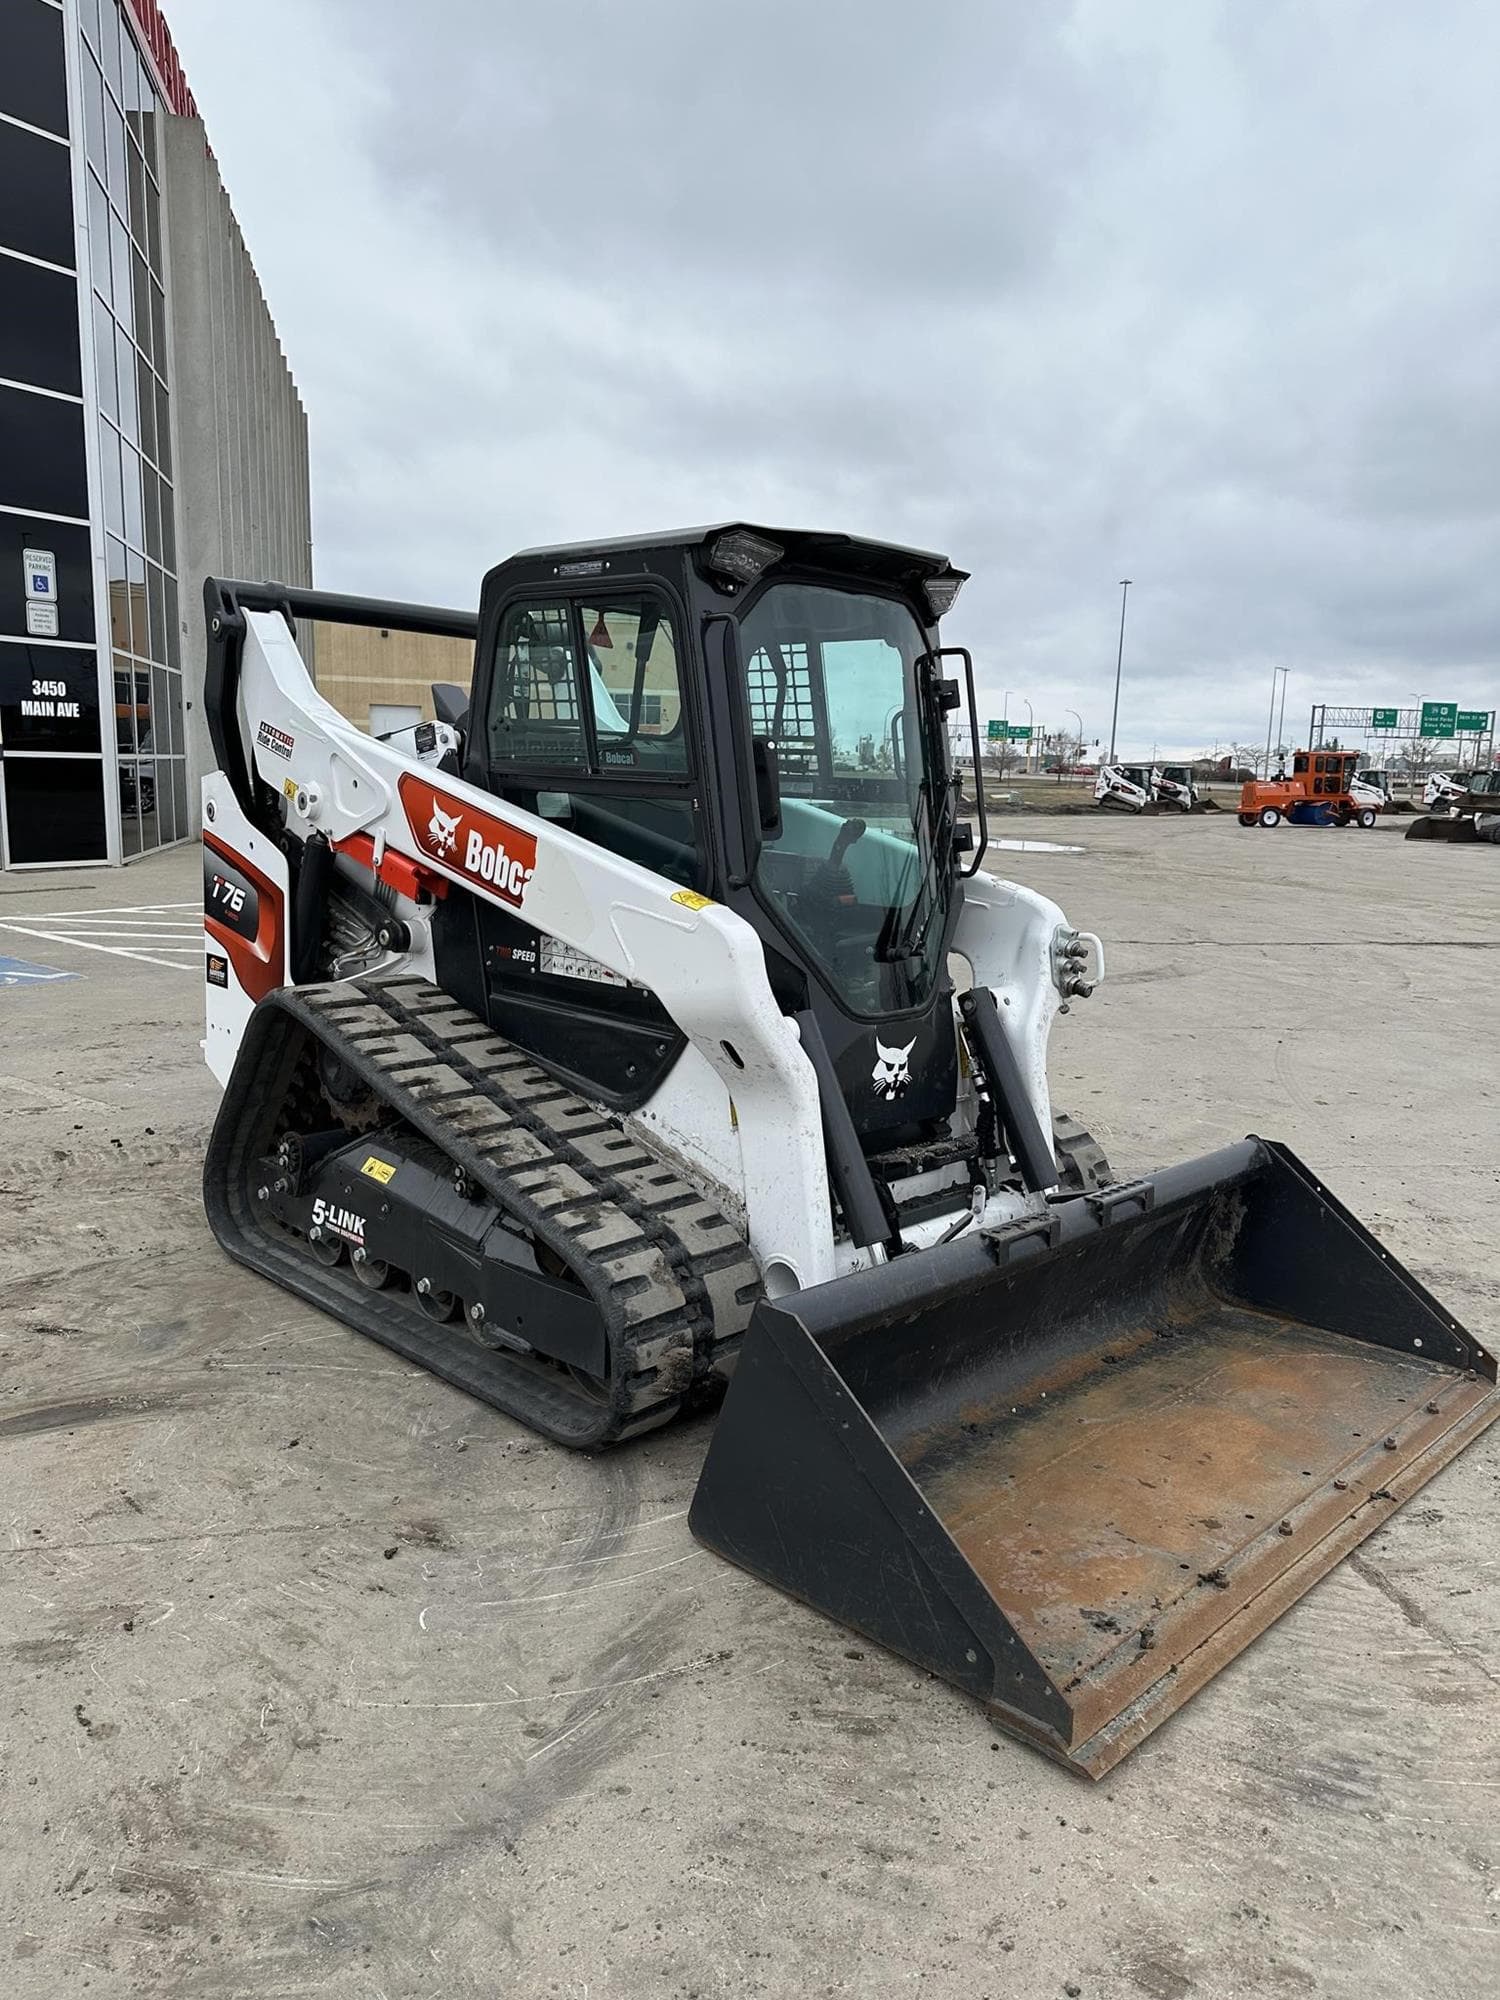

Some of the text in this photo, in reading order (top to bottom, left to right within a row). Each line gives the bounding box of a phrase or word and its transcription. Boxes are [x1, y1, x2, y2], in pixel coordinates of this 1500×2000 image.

[31, 679, 67, 697] 3450
[21, 700, 80, 718] MAIN AVE
[257, 731, 293, 759] Ride Control
[605, 751, 634, 765] Bobcat
[212, 875, 247, 912] T76
[511, 948, 536, 962] SPEED
[312, 1198, 367, 1237] 5-LINK
